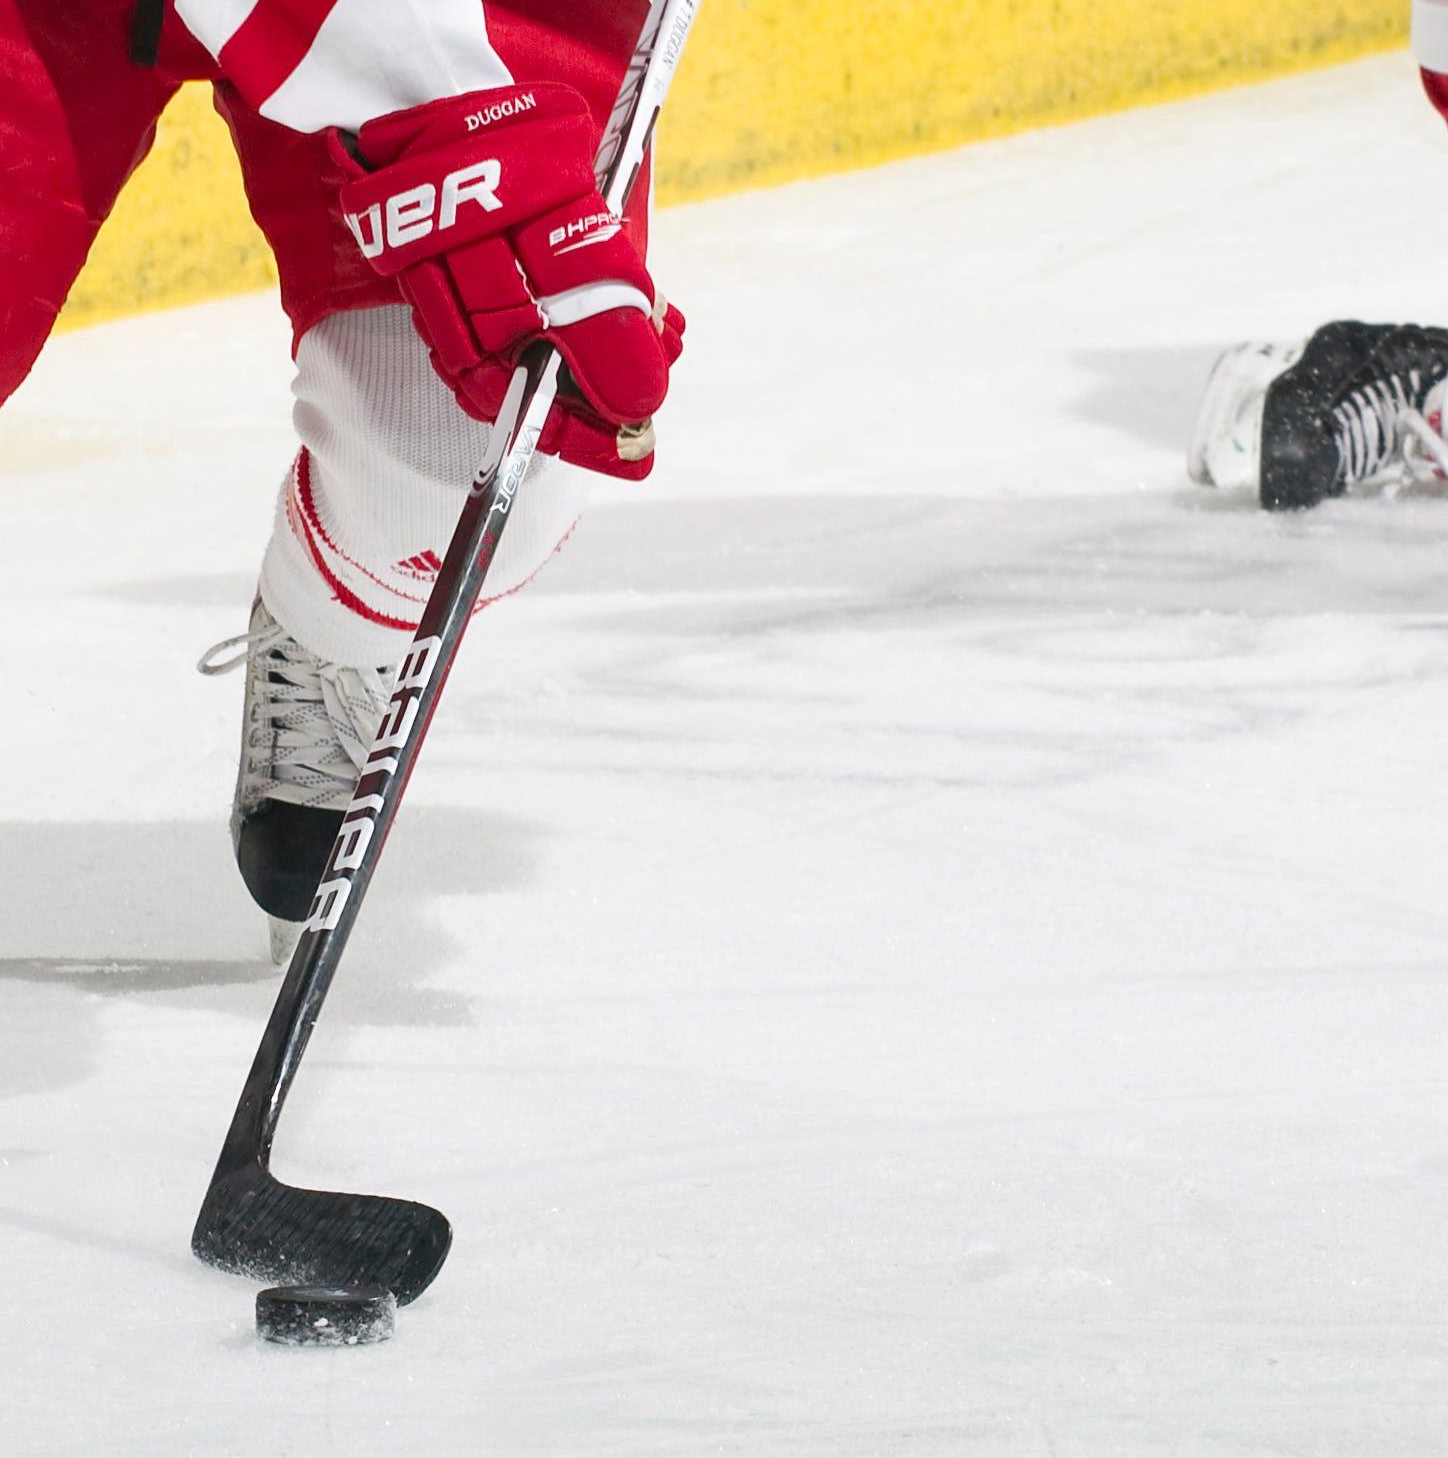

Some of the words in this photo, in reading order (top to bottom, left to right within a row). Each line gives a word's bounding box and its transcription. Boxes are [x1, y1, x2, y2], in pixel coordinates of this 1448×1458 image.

[464, 93, 537, 132] DUGGAN
[490, 424, 542, 515] VAPOR
[302, 634, 443, 935] BAUER
